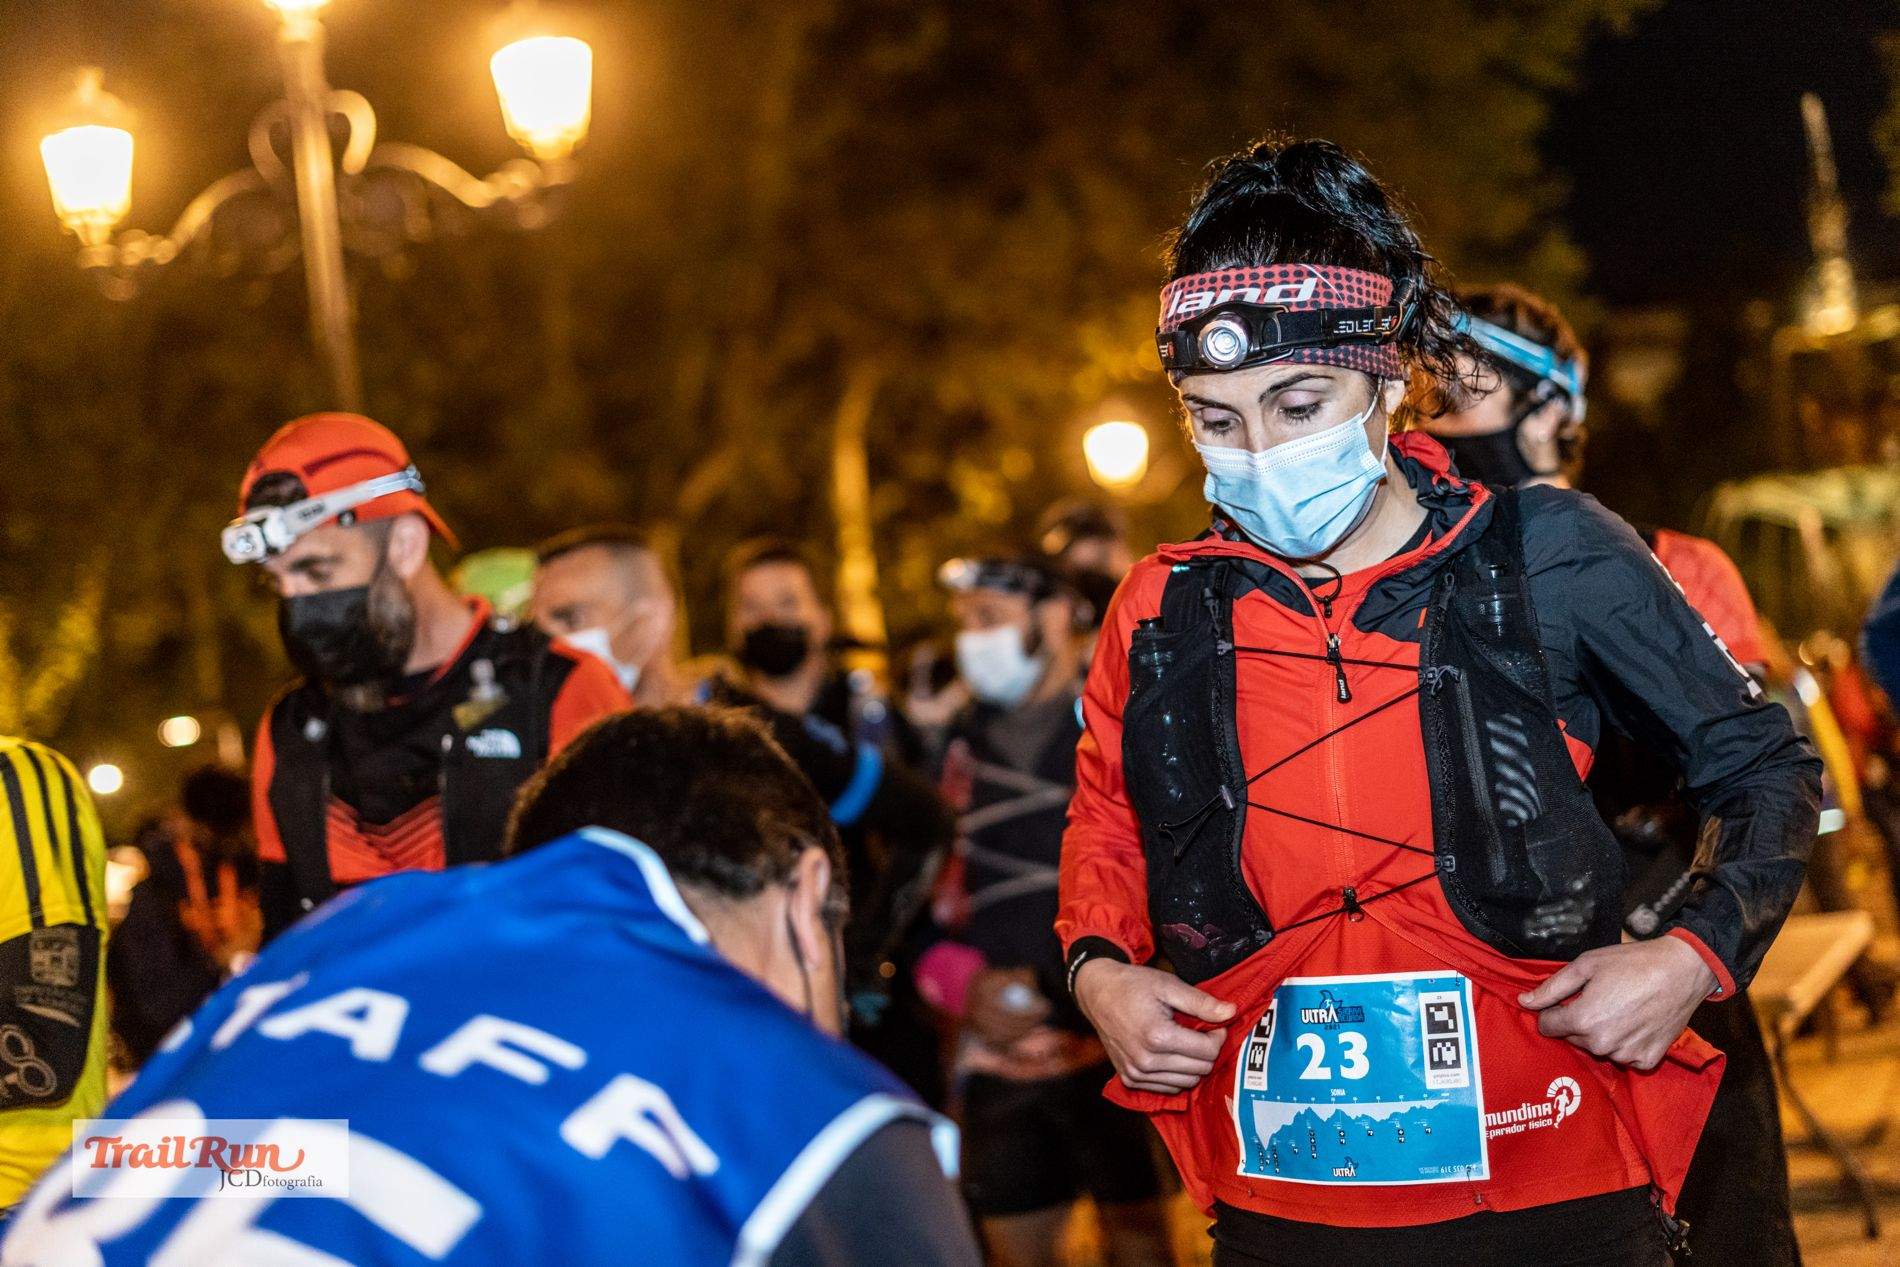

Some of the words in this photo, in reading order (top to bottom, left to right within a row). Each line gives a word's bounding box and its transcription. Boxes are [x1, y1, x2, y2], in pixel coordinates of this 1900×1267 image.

[1168, 278, 1317, 318] land
[1301, 1003, 1339, 1024] ULTRA
[1296, 1031, 1370, 1080] 23
[1330, 1088, 1346, 1097] SONIA
